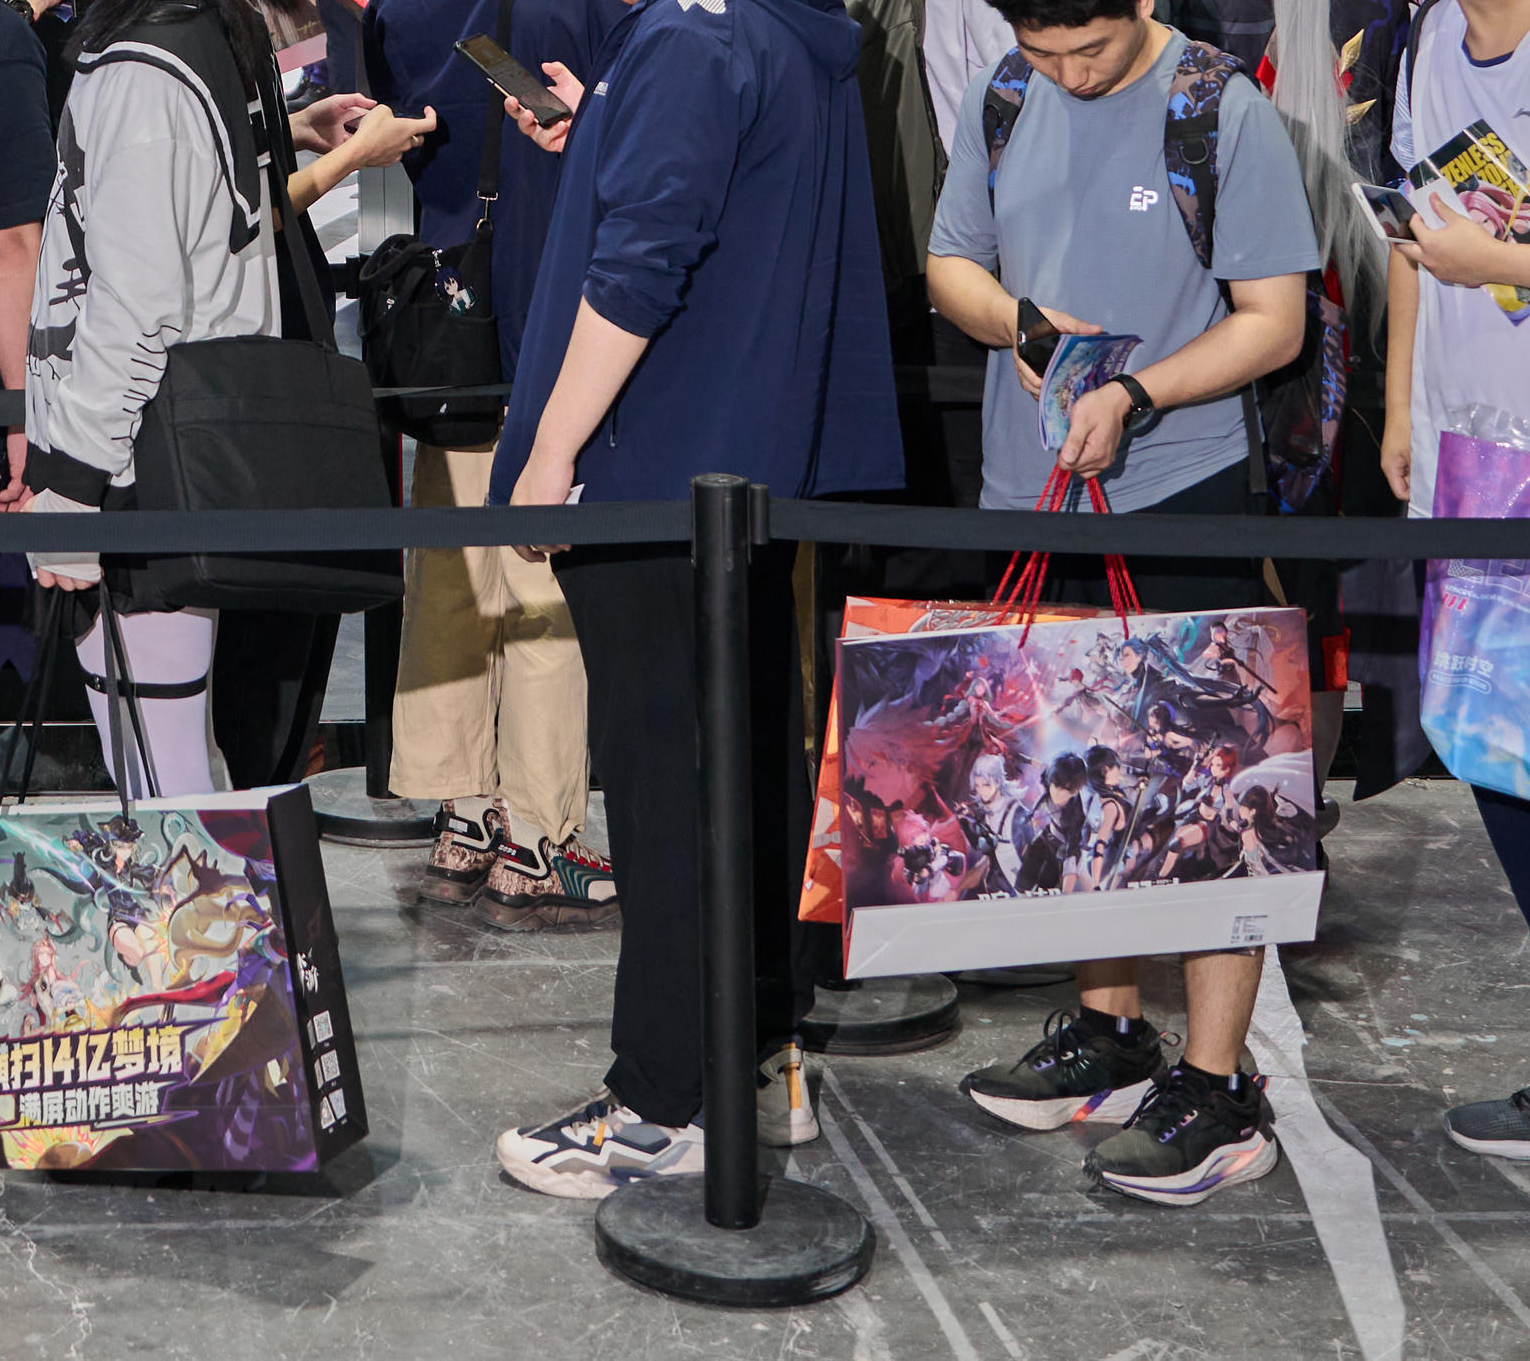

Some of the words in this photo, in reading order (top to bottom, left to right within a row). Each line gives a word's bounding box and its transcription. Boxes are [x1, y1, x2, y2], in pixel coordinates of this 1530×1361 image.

[19, 1082, 162, 1128] 满屏动作爽游
